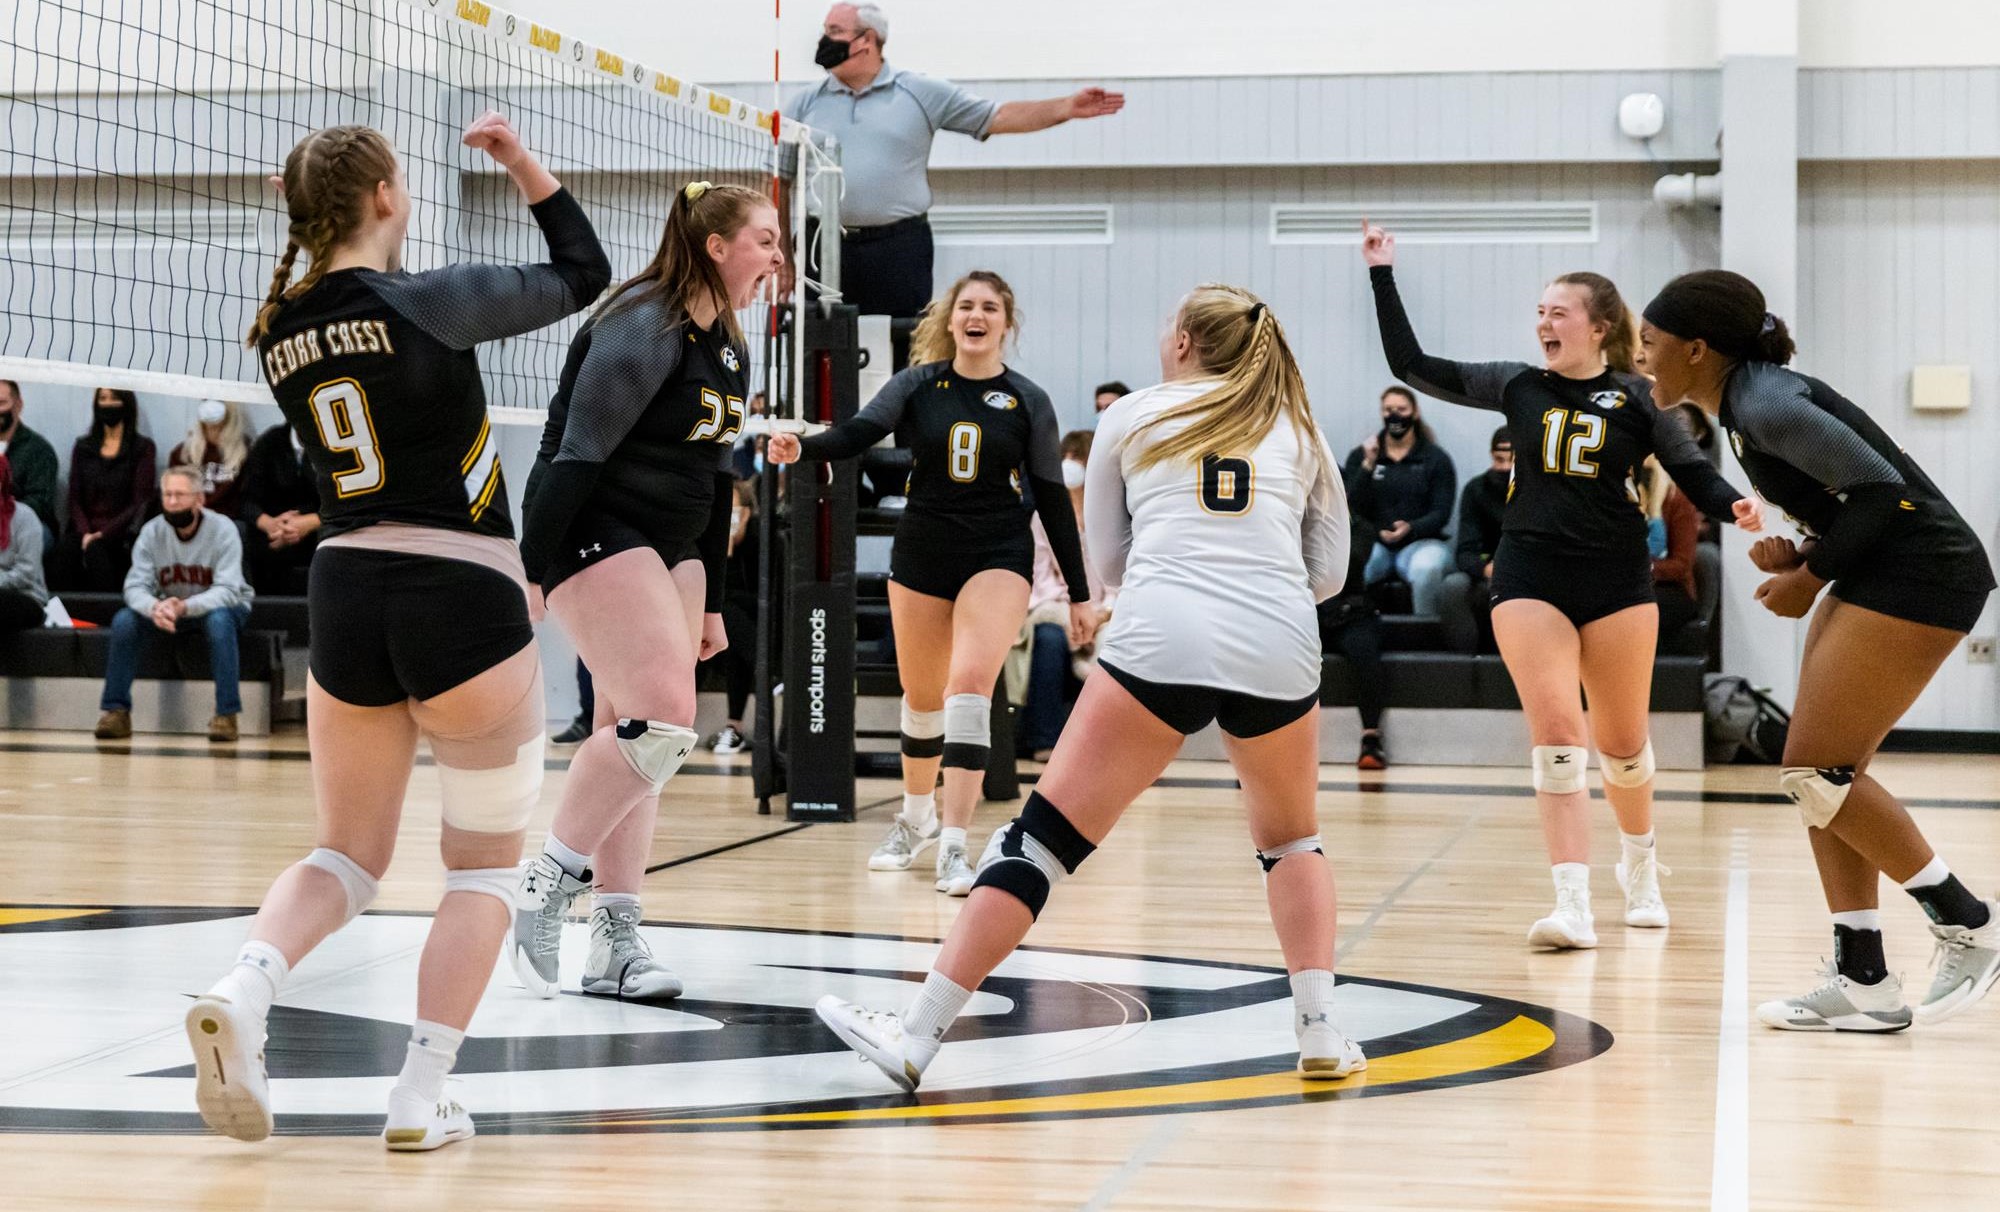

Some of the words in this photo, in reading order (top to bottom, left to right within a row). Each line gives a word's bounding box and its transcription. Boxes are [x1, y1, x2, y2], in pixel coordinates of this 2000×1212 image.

[265, 328, 324, 387] CEDAR
[325, 319, 395, 354] CREST
[308, 376, 386, 499] 9
[948, 421, 983, 484] 8
[1542, 406, 1607, 479] 12
[808, 607, 828, 664] sports
[807, 665, 827, 734] imports
